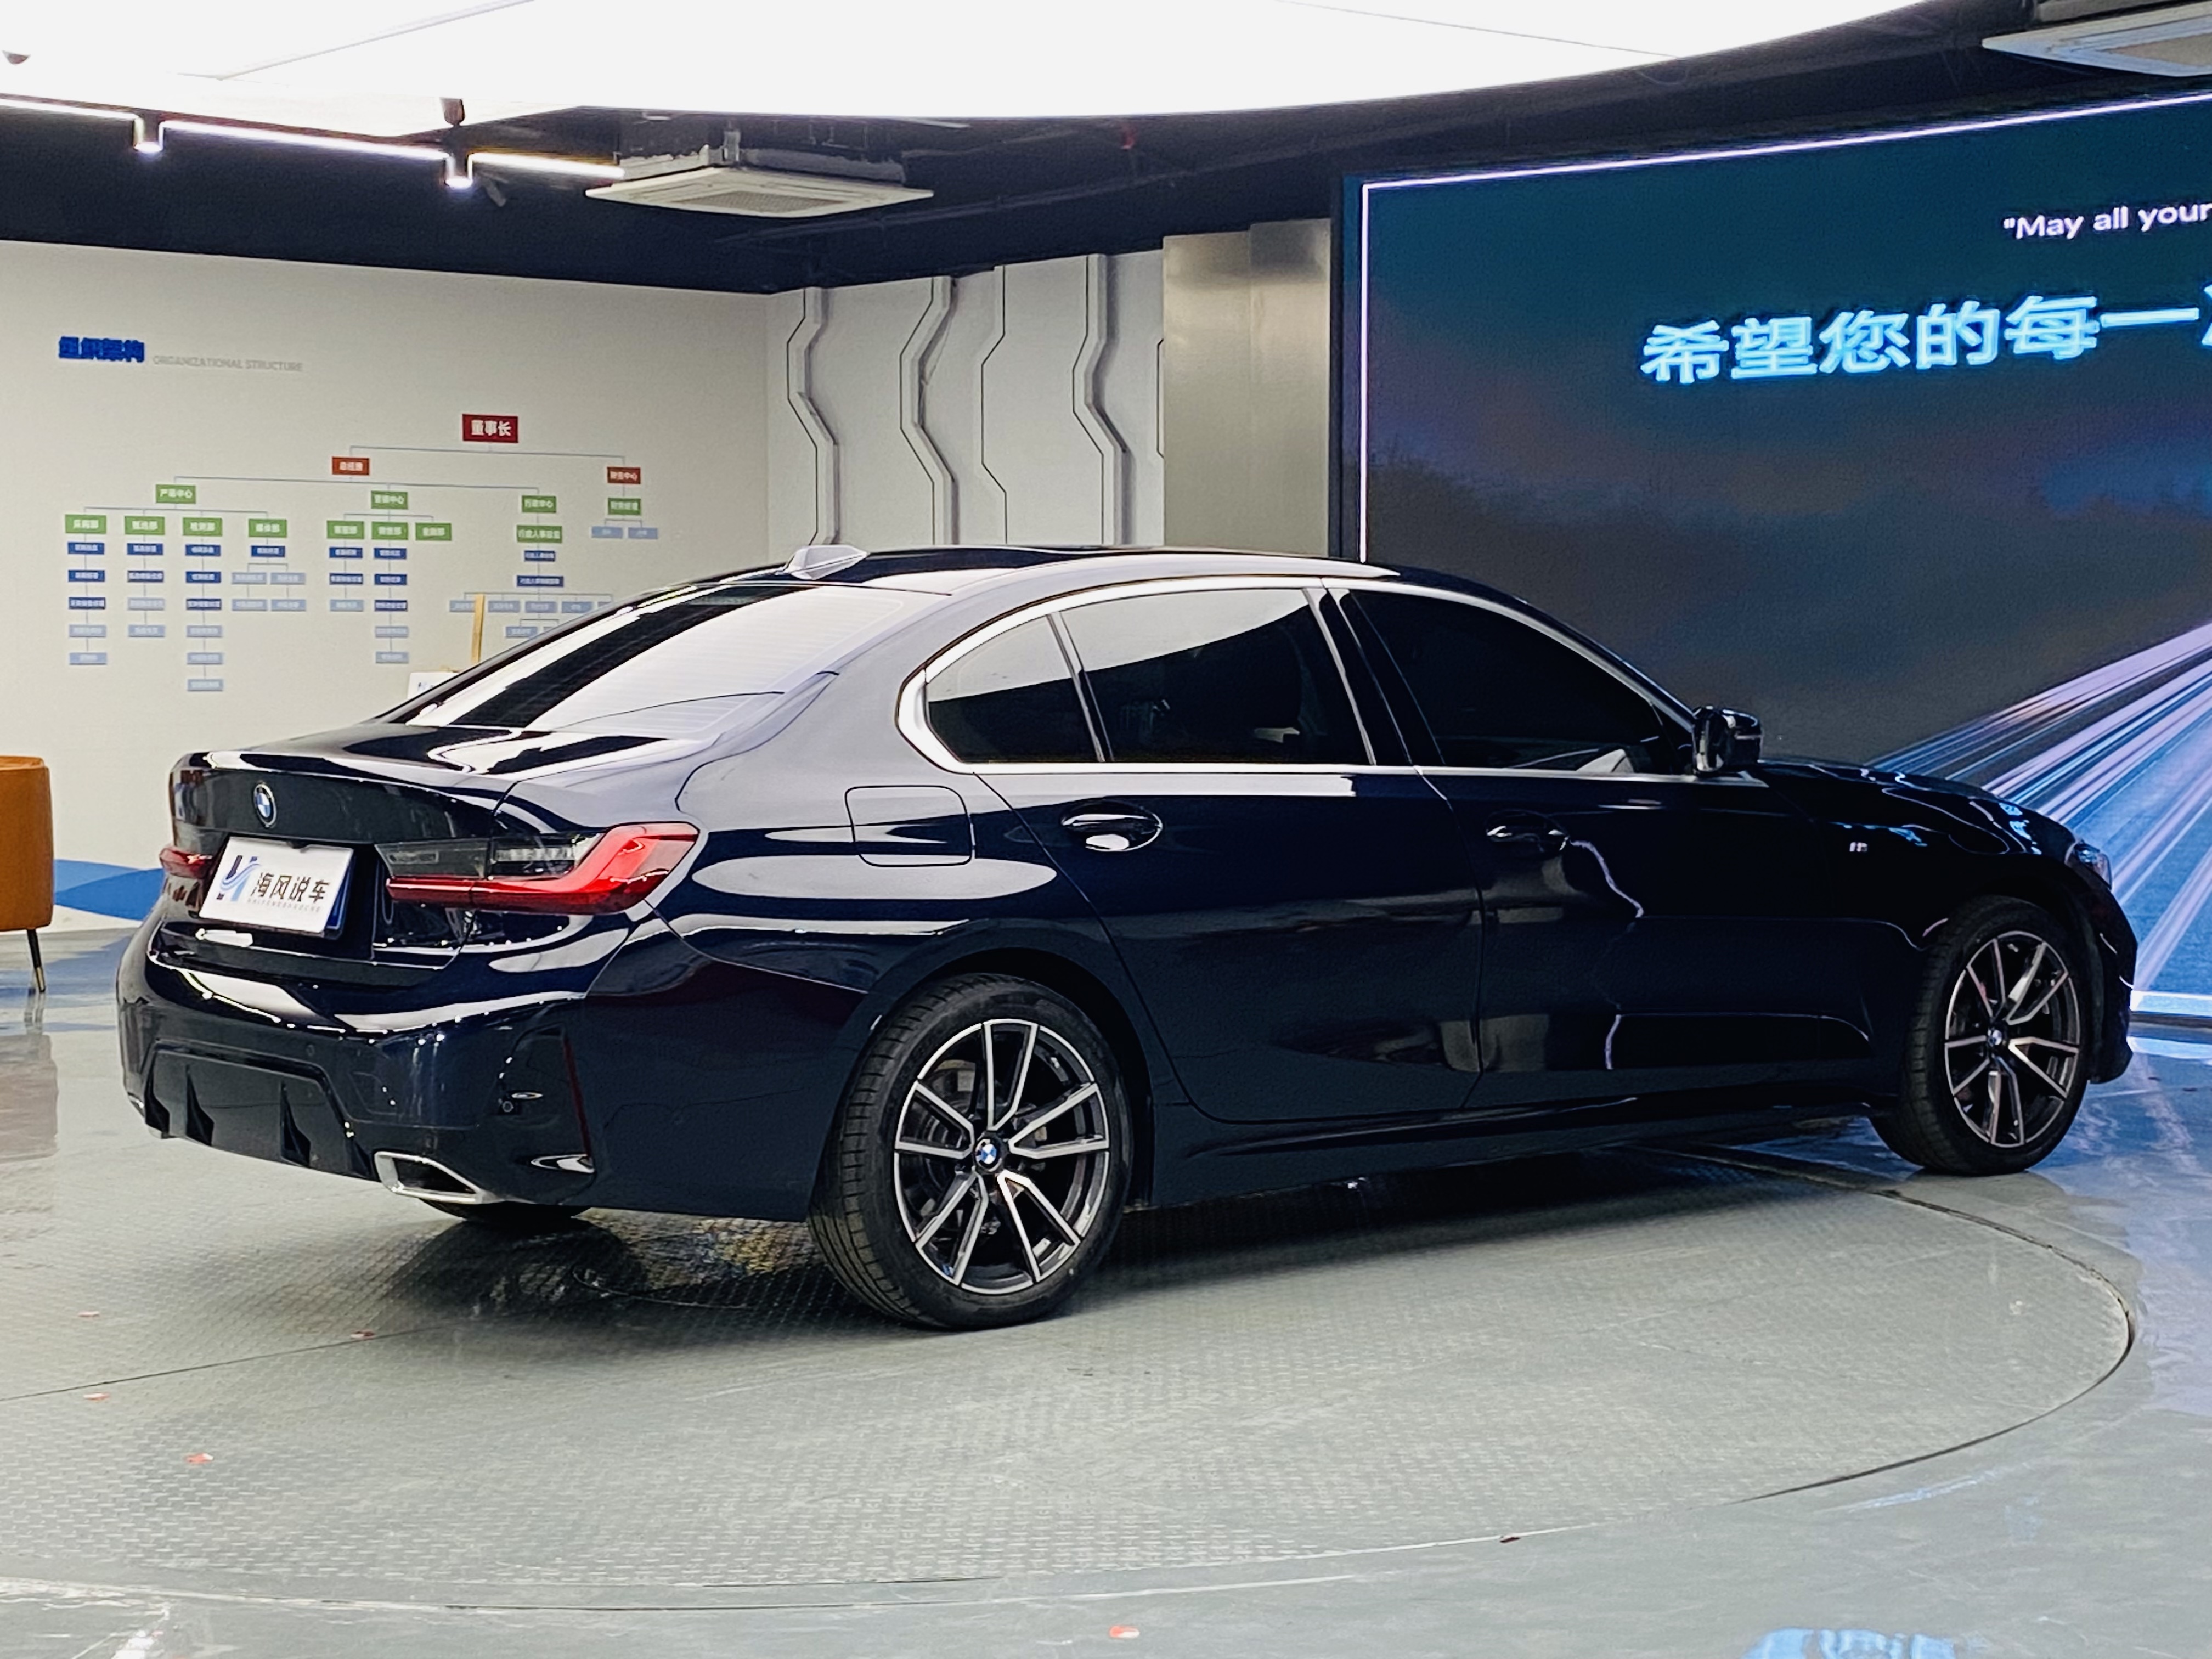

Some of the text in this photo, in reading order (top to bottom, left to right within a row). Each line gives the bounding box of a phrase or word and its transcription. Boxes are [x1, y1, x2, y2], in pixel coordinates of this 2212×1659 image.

[2003, 201, 2212, 240] "May all your
[1640, 284, 2212, 385] 希望您的每一
[245, 359, 303, 372] STRUCTURE
[250, 872, 330, 903] 海风说车
